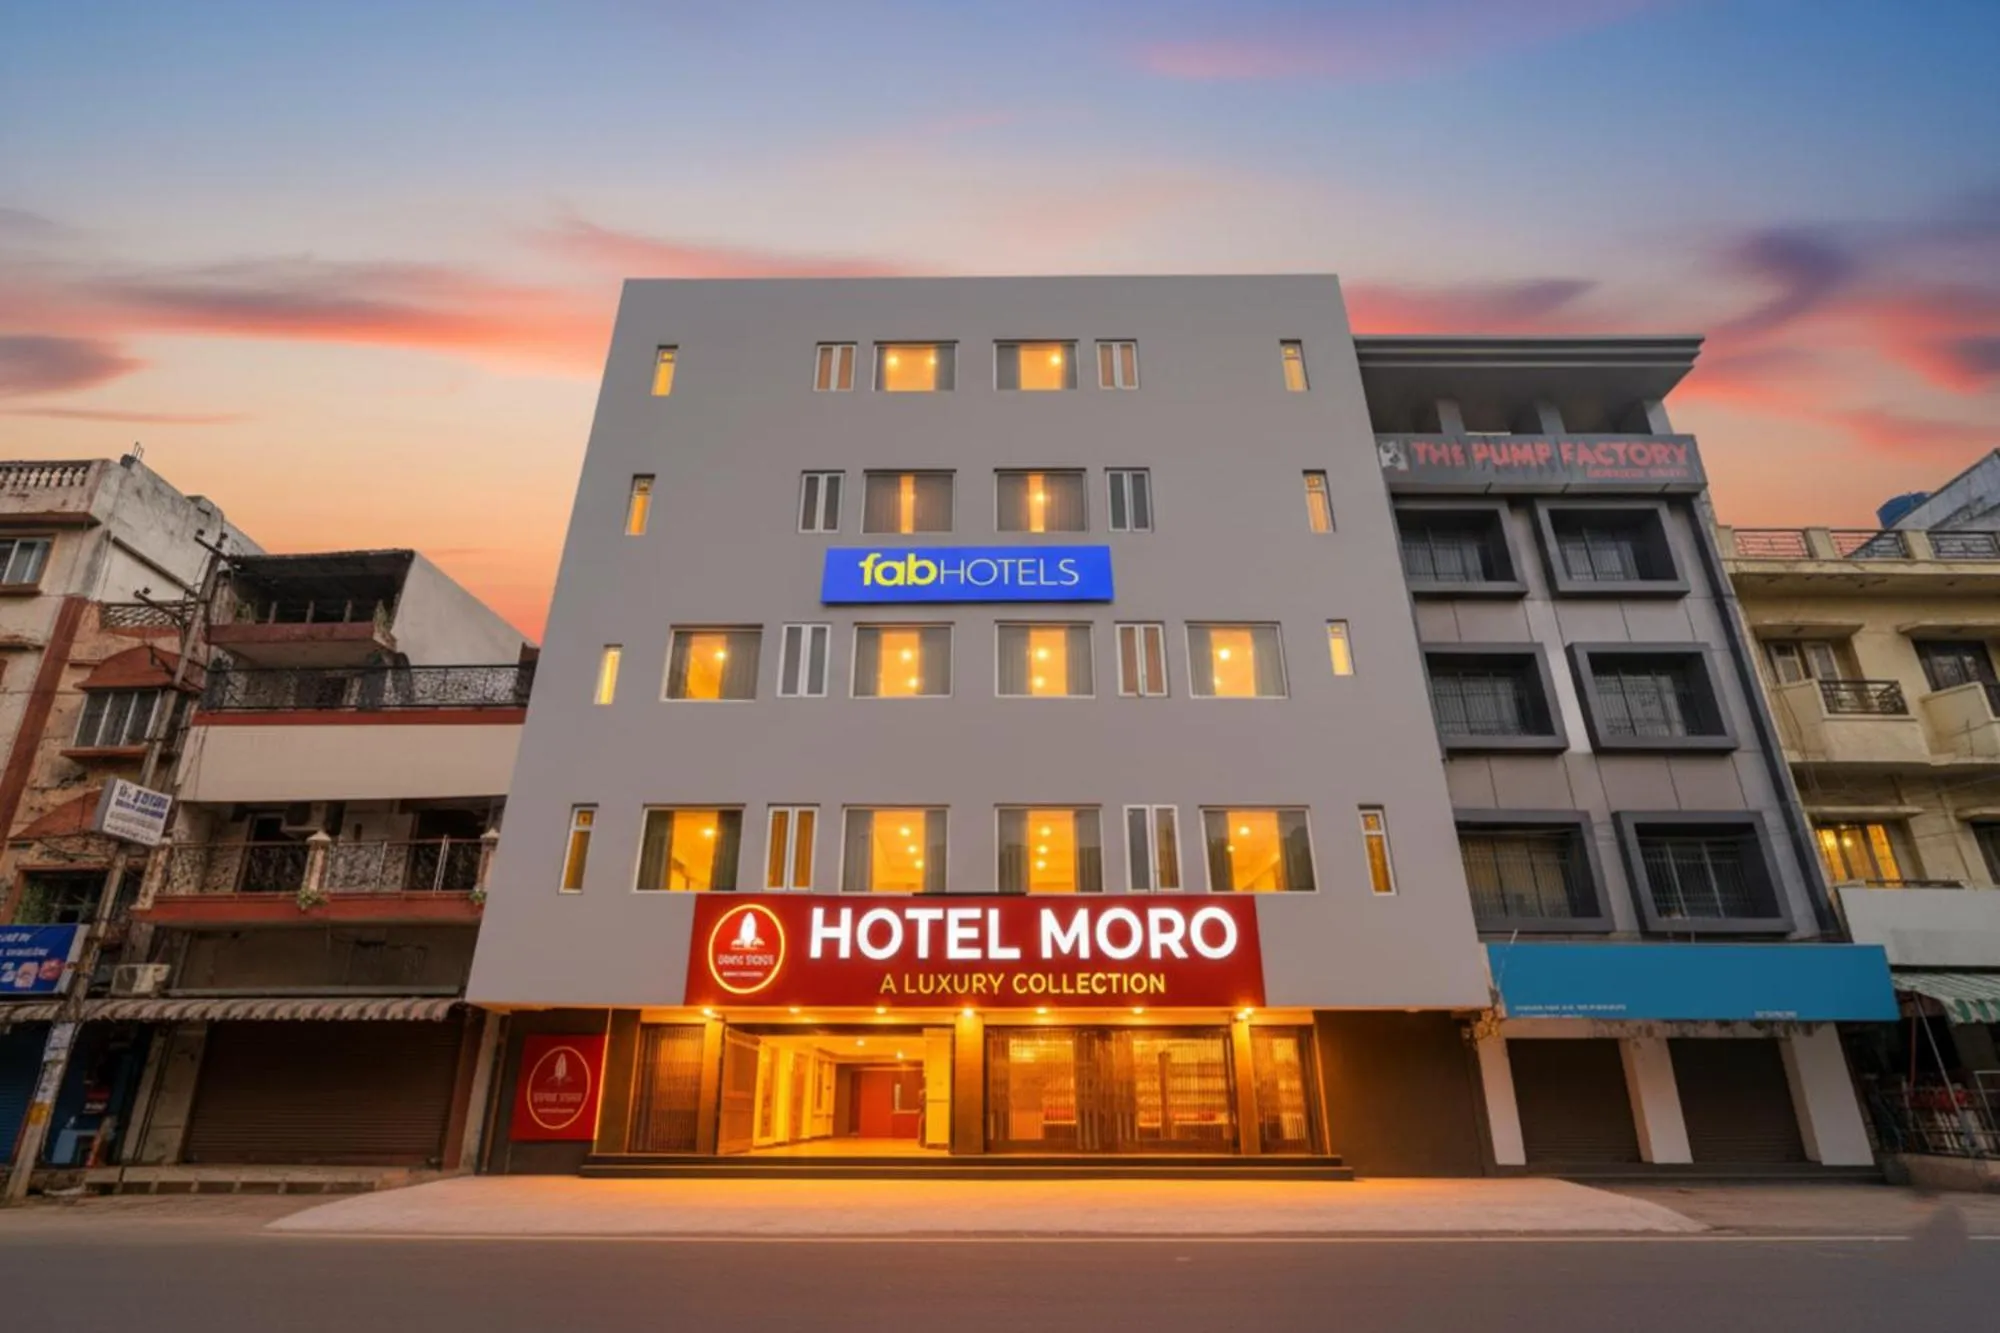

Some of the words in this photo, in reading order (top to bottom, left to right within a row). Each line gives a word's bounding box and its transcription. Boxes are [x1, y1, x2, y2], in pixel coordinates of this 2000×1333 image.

[1411, 441, 1466, 467] THE
[1471, 442, 1553, 467] PUMP
[1560, 441, 1689, 467] FACTORY
[809, 907, 1021, 960] HOTEL
[1041, 906, 1239, 960] MORO
[879, 974, 897, 994] A
[904, 973, 1006, 995] LUXURY
[1012, 973, 1166, 995] COLLECTION
